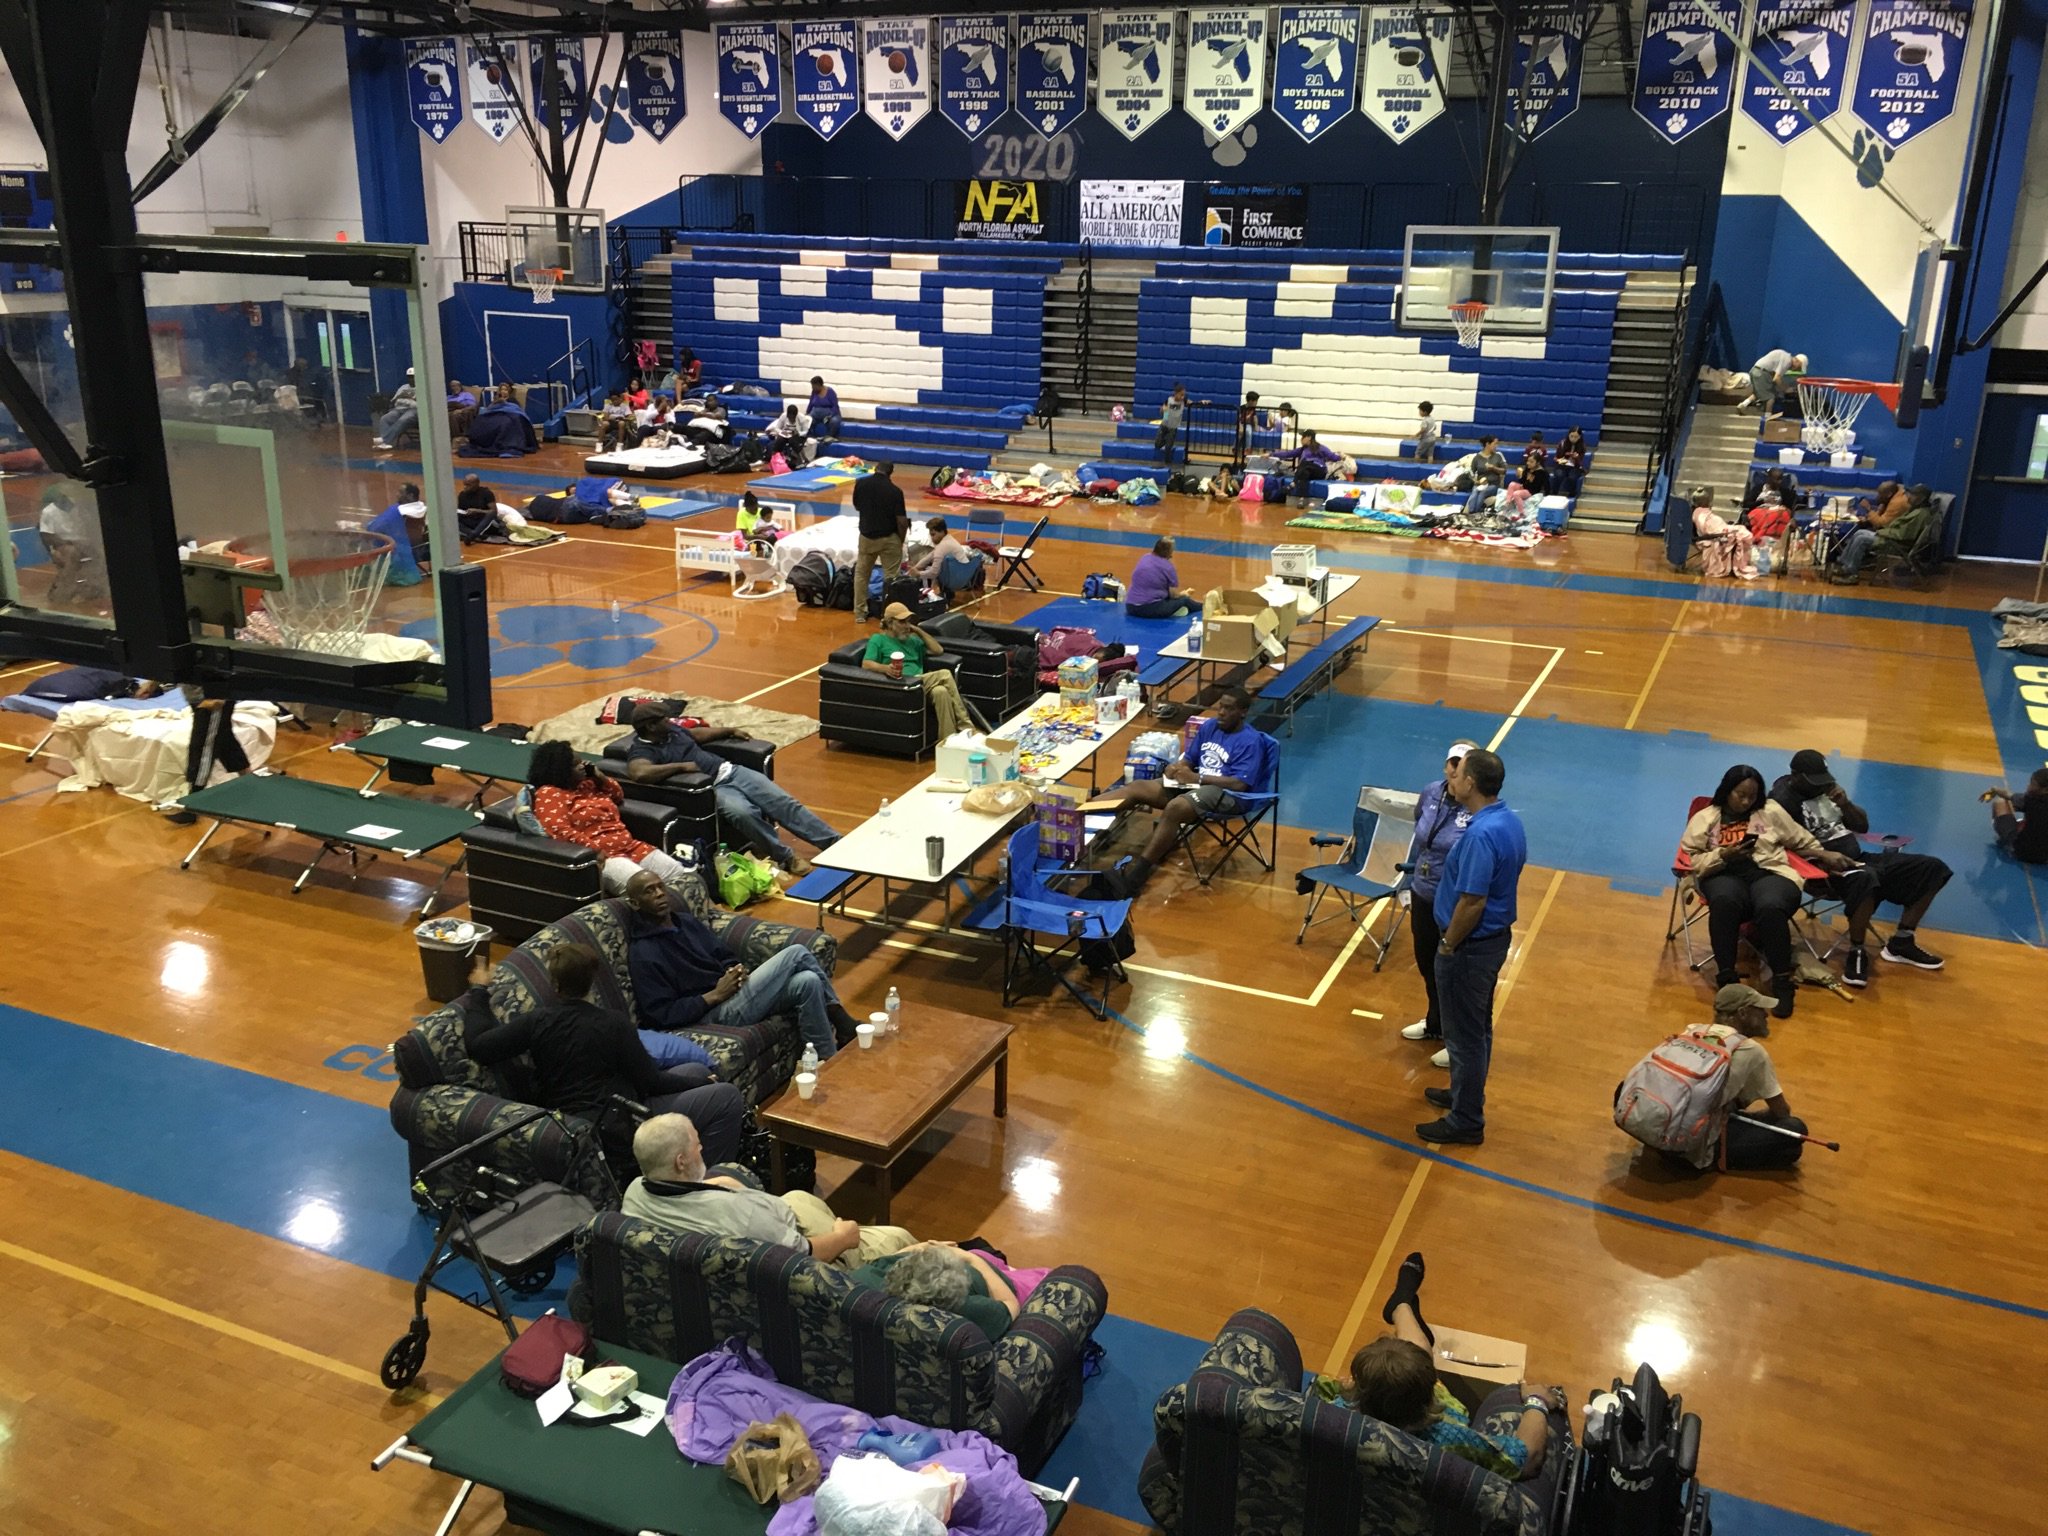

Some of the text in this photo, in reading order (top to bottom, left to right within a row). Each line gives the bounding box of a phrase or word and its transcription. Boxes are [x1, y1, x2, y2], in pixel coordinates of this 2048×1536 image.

[1779, 0, 1834, 9] STATE
[1893, 0, 1952, 10] STATE
[1116, 14, 1158, 22] STATE
[1207, 11, 1250, 19] STATE
[1298, 9, 1342, 18] STATE
[877, 20, 914, 29] STATE
[955, 18, 993, 26] STATE
[1033, 16, 1073, 24] STATE
[1757, 9, 1850, 39] CHAMPIONS
[1869, 10, 1968, 40] CHAMPIONS
[730, 26, 764, 35] STATE
[806, 23, 842, 32] STATE
[1281, 18, 1357, 45] CHAMPIONS
[943, 26, 1006, 50] CHAMPIONS
[1020, 24, 1085, 49] CHAMPIONS
[1102, 23, 1171, 49] RUNNER-UP
[1191, 20, 1263, 47] RUNNER-UP
[720, 34, 776, 57] CHAMPIONS
[794, 31, 854, 55] CHAMPIONS
[866, 29, 926, 55] RUNNER-UP
[531, 39, 582, 64] CHPIONS
[408, 47, 456, 68] CHAMPIONS
[966, 77, 981, 88] 5A
[1042, 77, 1059, 88] 4A
[1127, 76, 1143, 87] 2A
[1216, 75, 1232, 86] 2A
[1305, 74, 1323, 86] 2A
[1396, 74, 1415, 86] 3A
[1673, 71, 1694, 84] 2A
[1783, 71, 1805, 84] 2A
[1896, 73, 1919, 86] 5A
[742, 82, 756, 93] 3A
[818, 80, 833, 91] 5A
[1645, 86, 1719, 95] BOYS TRACK
[816, 93, 855, 101] BASKETBALL
[947, 91, 1000, 99] BOYS TRACK
[1283, 89, 1345, 97] BOYS TRACK
[1377, 89, 1432, 98] FOOTBALL
[1788, 87, 1831, 96] TRACK
[1870, 88, 1940, 99] FOOTBALL
[737, 104, 764, 113] 1988
[812, 103, 841, 112] 1997
[959, 101, 989, 110] 1998
[1034, 101, 1065, 111] 2001
[1116, 100, 1150, 111] 2004
[1295, 100, 1331, 110] 2006
[1659, 97, 1701, 109] 2010
[1880, 101, 1925, 114] 2012
[426, 112, 449, 121] 1976
[646, 107, 670, 116] 1987
[978, 132, 1075, 180] 2020
[1237, 186, 1250, 195] the
[1251, 186, 1276, 195] Power
[1277, 187, 1286, 195] of
[963, 180, 1040, 224] NFA
[1080, 201, 1181, 222] ALL AMERICAN
[958, 222, 1044, 234] NORTH FLORIDA ASPHALT
[1080, 221, 1180, 239] MOBILE HOME & OFFICE
[1241, 226, 1304, 240] COMMERCE
[1610, 1466, 1655, 1492] drive
